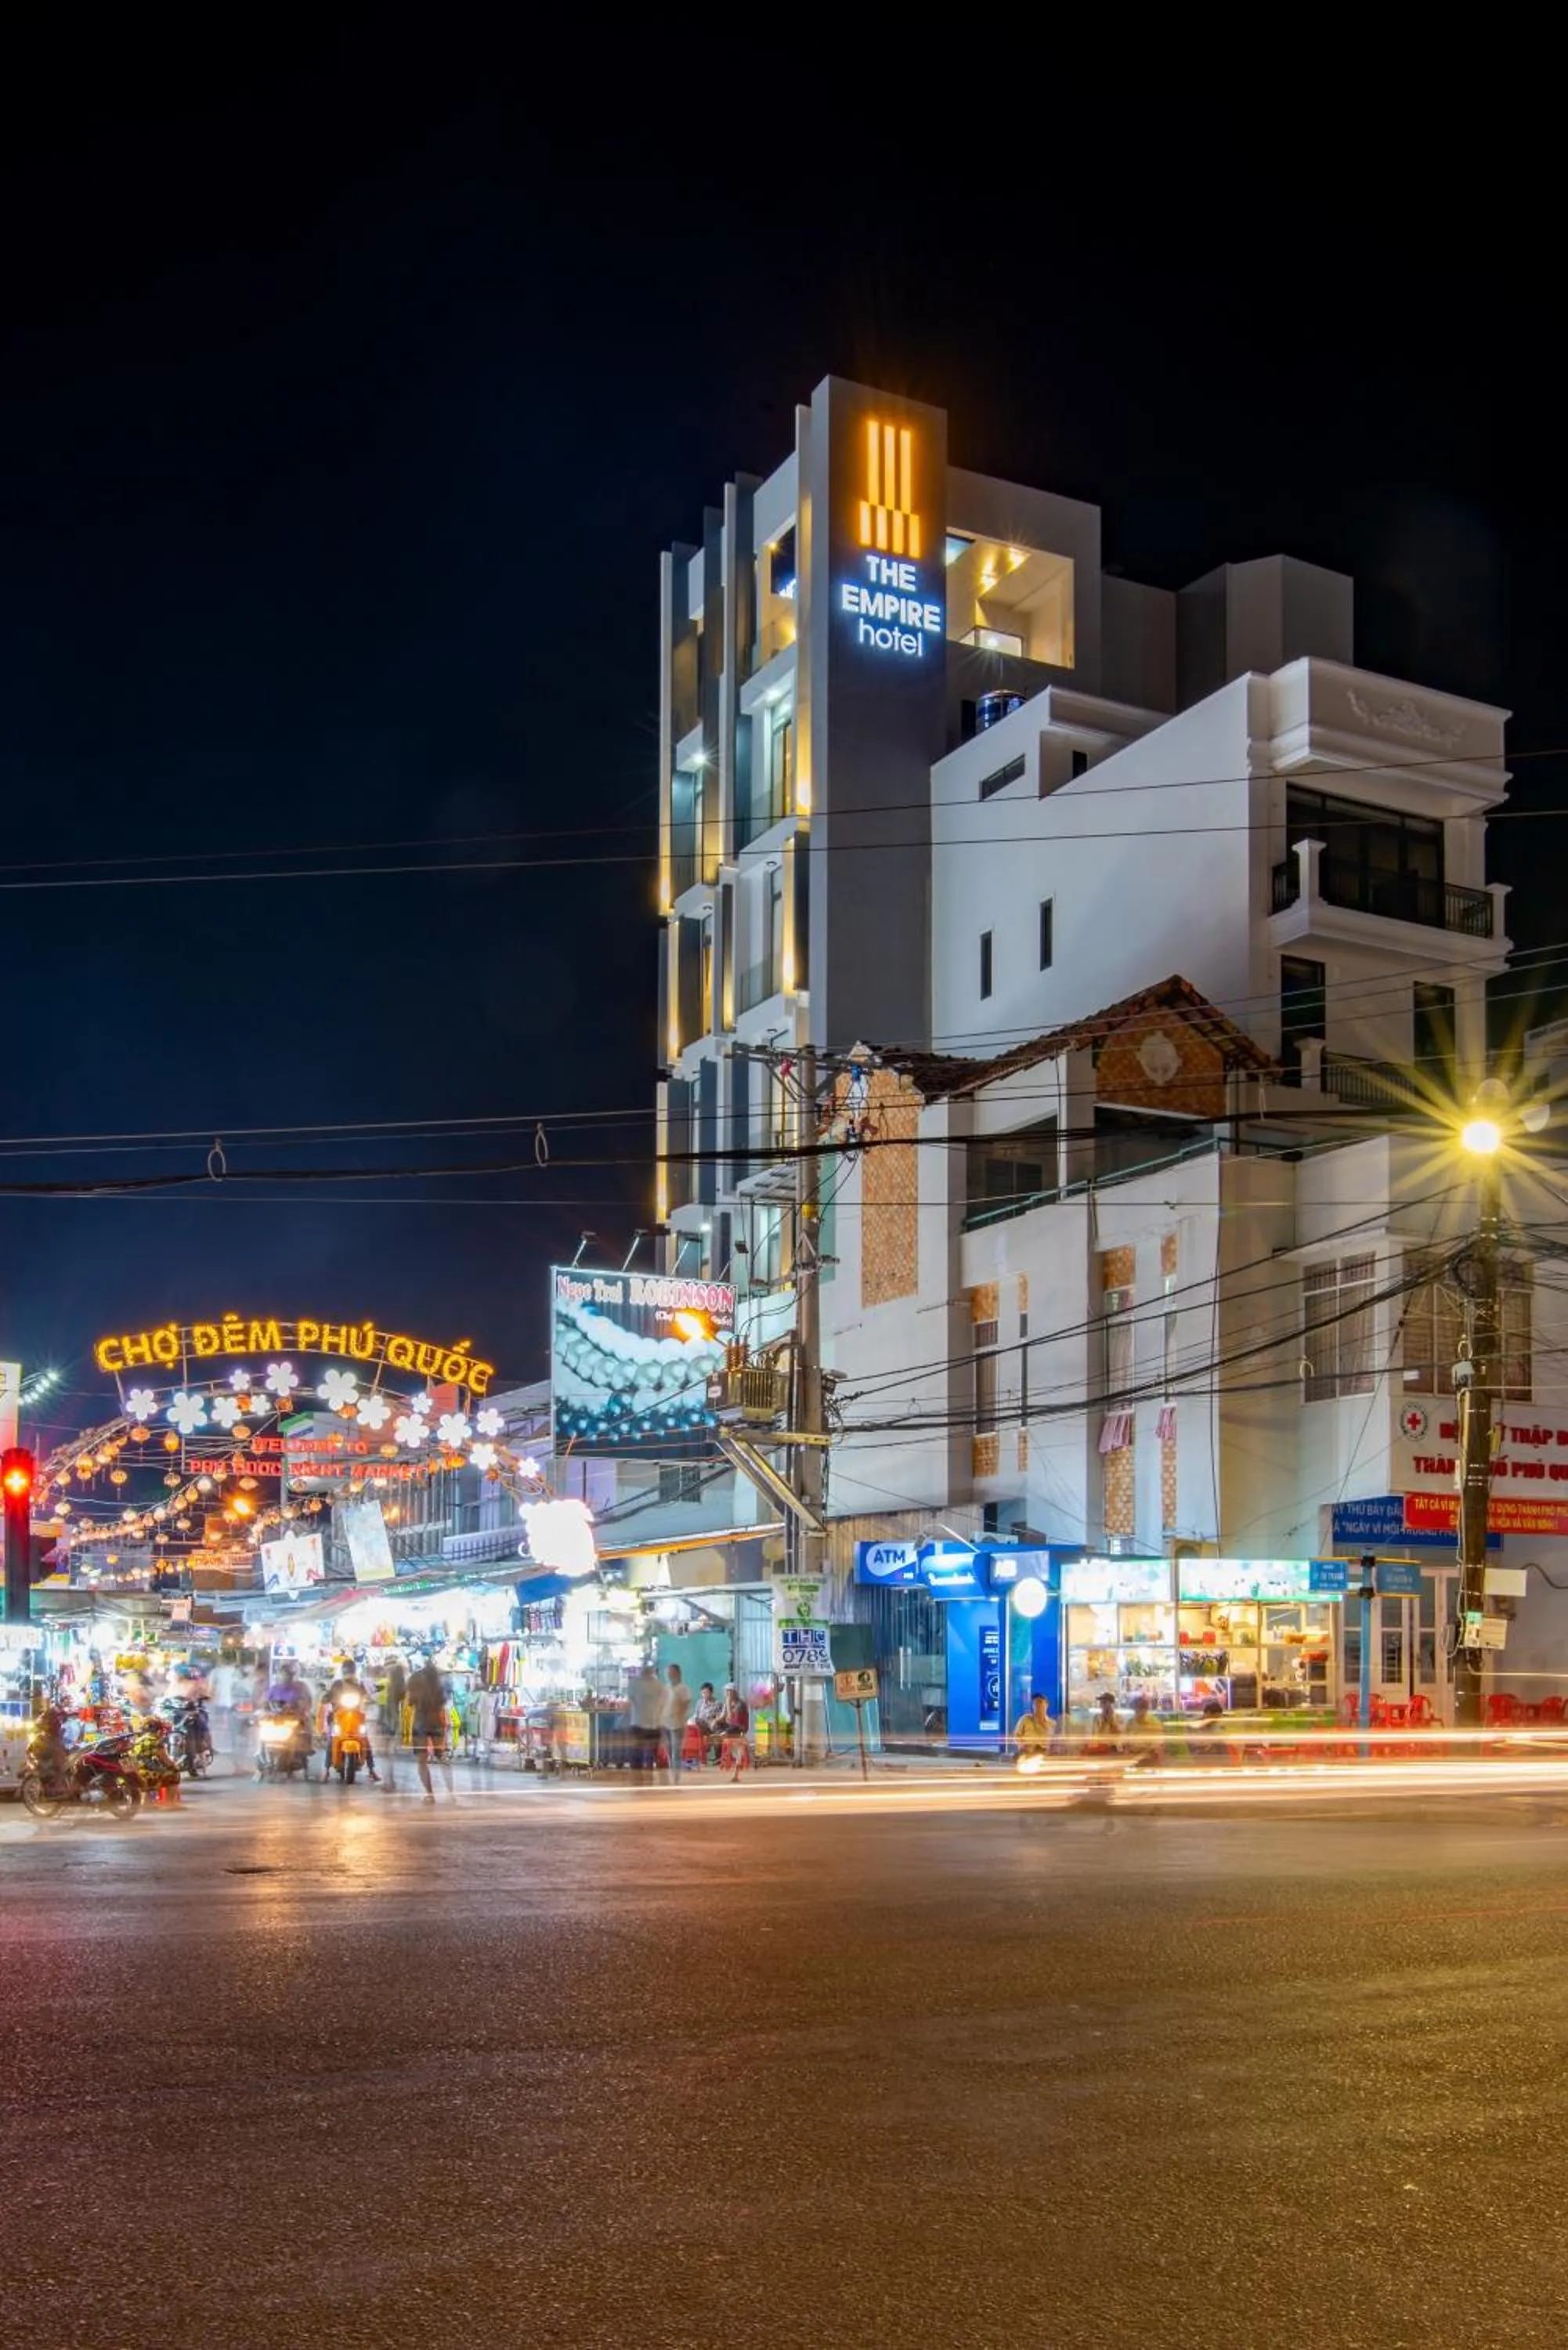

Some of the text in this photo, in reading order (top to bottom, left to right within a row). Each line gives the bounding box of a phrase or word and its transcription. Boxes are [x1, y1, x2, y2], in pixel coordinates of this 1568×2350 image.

[865, 555, 916, 591] THE
[841, 584, 941, 632] EMPIRE
[858, 618, 923, 657] hotel
[629, 1278, 734, 1313] ROBINSON
[96, 1312, 494, 1394] CHỢ ĐÊM PHÚ QUỐC
[873, 1549, 905, 1564] ATM
